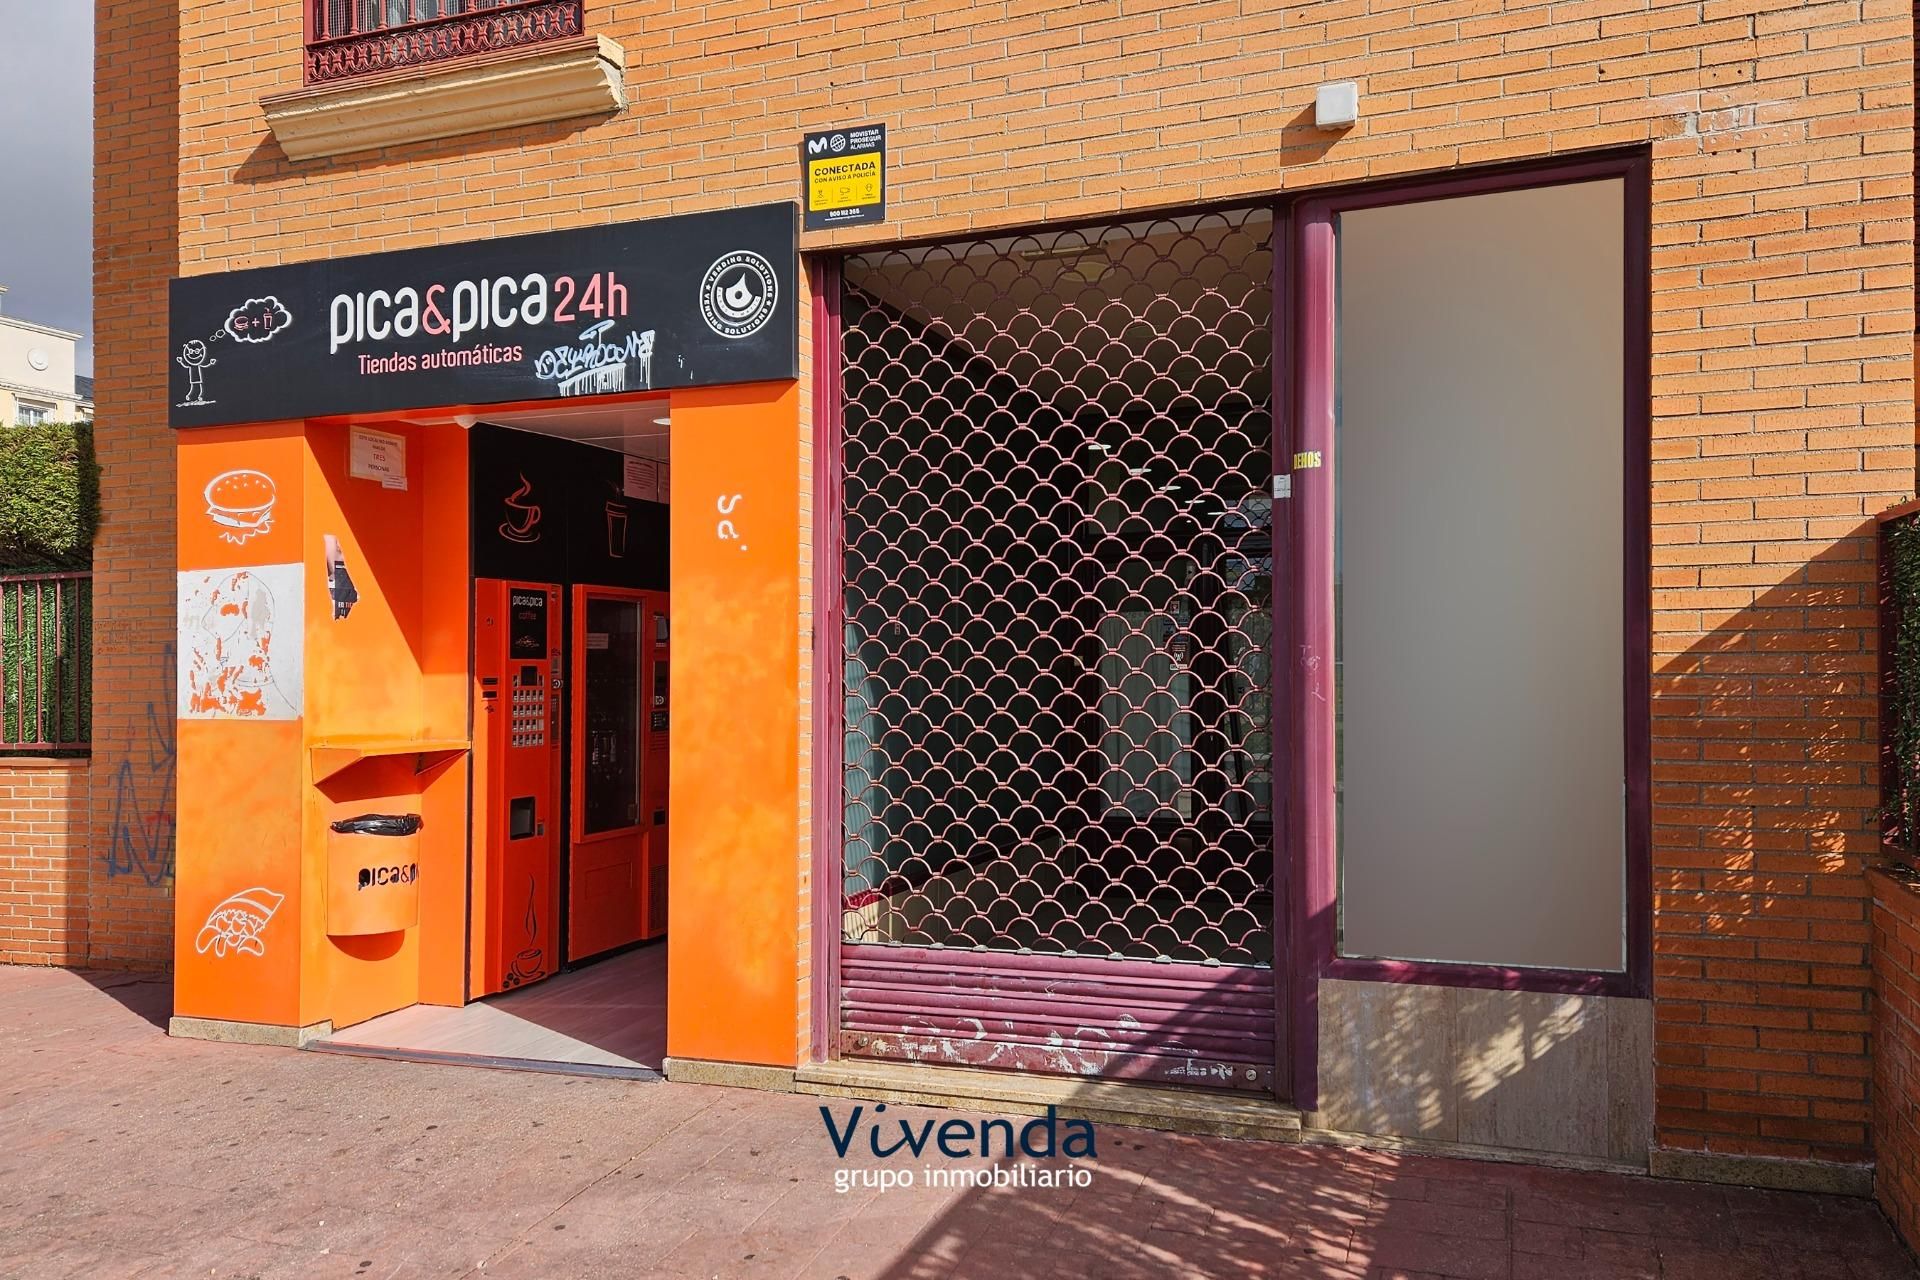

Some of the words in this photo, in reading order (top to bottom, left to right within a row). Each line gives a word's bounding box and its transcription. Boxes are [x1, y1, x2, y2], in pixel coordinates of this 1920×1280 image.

[850, 128, 879, 138] MOVISTAR
[850, 134, 882, 145] PROSEGUR
[850, 142, 876, 150] ALARMAS
[814, 161, 876, 177] CONECTADA
[814, 176, 828, 184] CON
[852, 170, 876, 179] POLICÍA
[708, 255, 742, 282] VENDING
[744, 256, 773, 298] SOLUTIONS
[330, 272, 548, 354] pica&pica
[553, 271, 628, 323] 24h
[703, 293, 723, 330] VENDING
[724, 307, 768, 335] SOLUTIONS
[358, 352, 417, 375] Tiendas
[421, 343, 523, 370] automáticas
[373, 453, 386, 461] TRES
